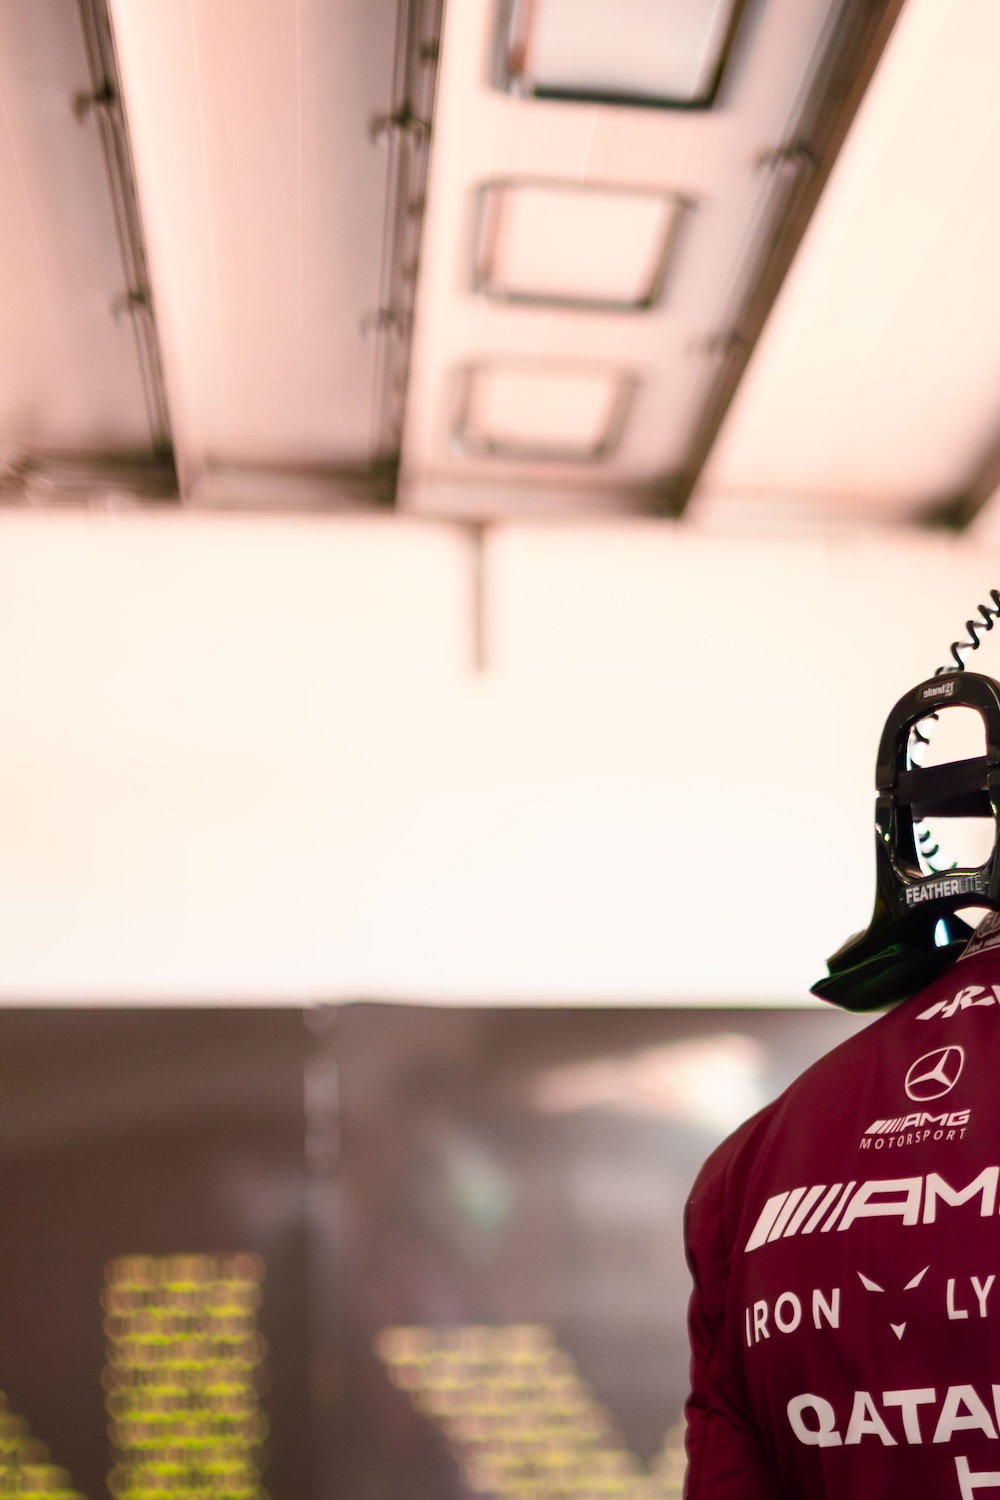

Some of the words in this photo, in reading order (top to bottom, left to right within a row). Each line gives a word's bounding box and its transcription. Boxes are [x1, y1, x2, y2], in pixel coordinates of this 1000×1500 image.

[906, 874, 983, 904] FEATHERLITE
[898, 1109, 971, 1132] AMG
[859, 1128, 968, 1150] MOTORSPORT
[745, 1288, 841, 1348] IRON
